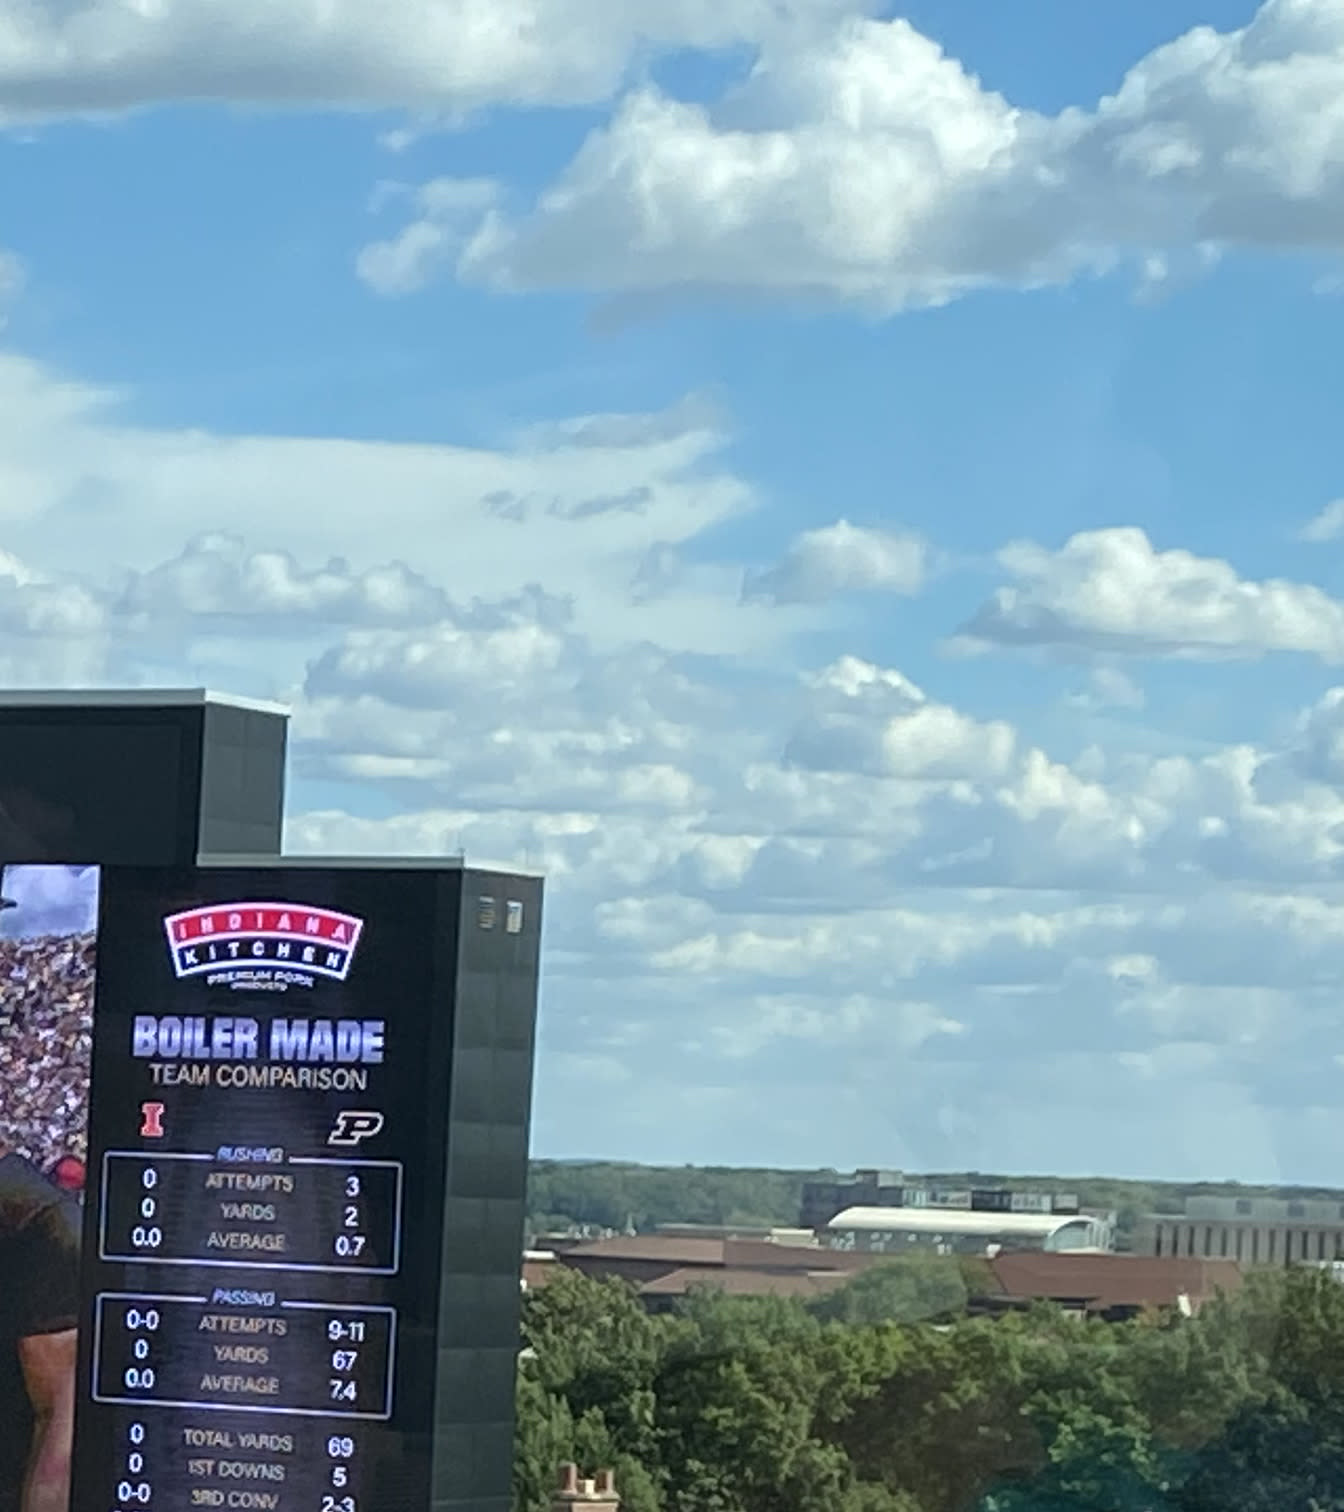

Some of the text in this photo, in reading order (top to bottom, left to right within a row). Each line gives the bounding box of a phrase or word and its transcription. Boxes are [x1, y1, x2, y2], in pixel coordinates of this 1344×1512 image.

[178, 912, 347, 939] INDIANA
[184, 940, 341, 968] KITCHEN
[133, 1015, 385, 1064] BOILER MADE
[149, 1064, 368, 1091] TEAM COMPARISON
[142, 1168, 157, 1188] 0
[205, 1173, 294, 1193] ATTEMPTS
[345, 1176, 360, 1197] 3
[141, 1198, 156, 1218] 0
[220, 1202, 276, 1221] YARDS
[344, 1206, 359, 1227] 2
[132, 1226, 162, 1248] 0.0
[207, 1232, 286, 1252] AVERAGE
[335, 1235, 366, 1257] 0.7
[126, 1309, 160, 1330] 0-0
[198, 1315, 287, 1337] ATTEMPTS
[328, 1320, 365, 1343] 9-11
[134, 1339, 149, 1360] 0
[214, 1345, 269, 1364] YARDS
[332, 1350, 358, 1371] 67
[125, 1368, 155, 1389] 0.0
[199, 1375, 280, 1395] AVERAGE
[329, 1380, 357, 1402] 7.4
[130, 1424, 145, 1445] 0
[183, 1428, 293, 1453] TOTAL YARDS
[328, 1437, 354, 1459] 69
[128, 1454, 143, 1475] 0
[332, 1467, 347, 1488] 5
[117, 1482, 151, 1504] 0-0
[191, 1489, 279, 1512] 3RD CONV
